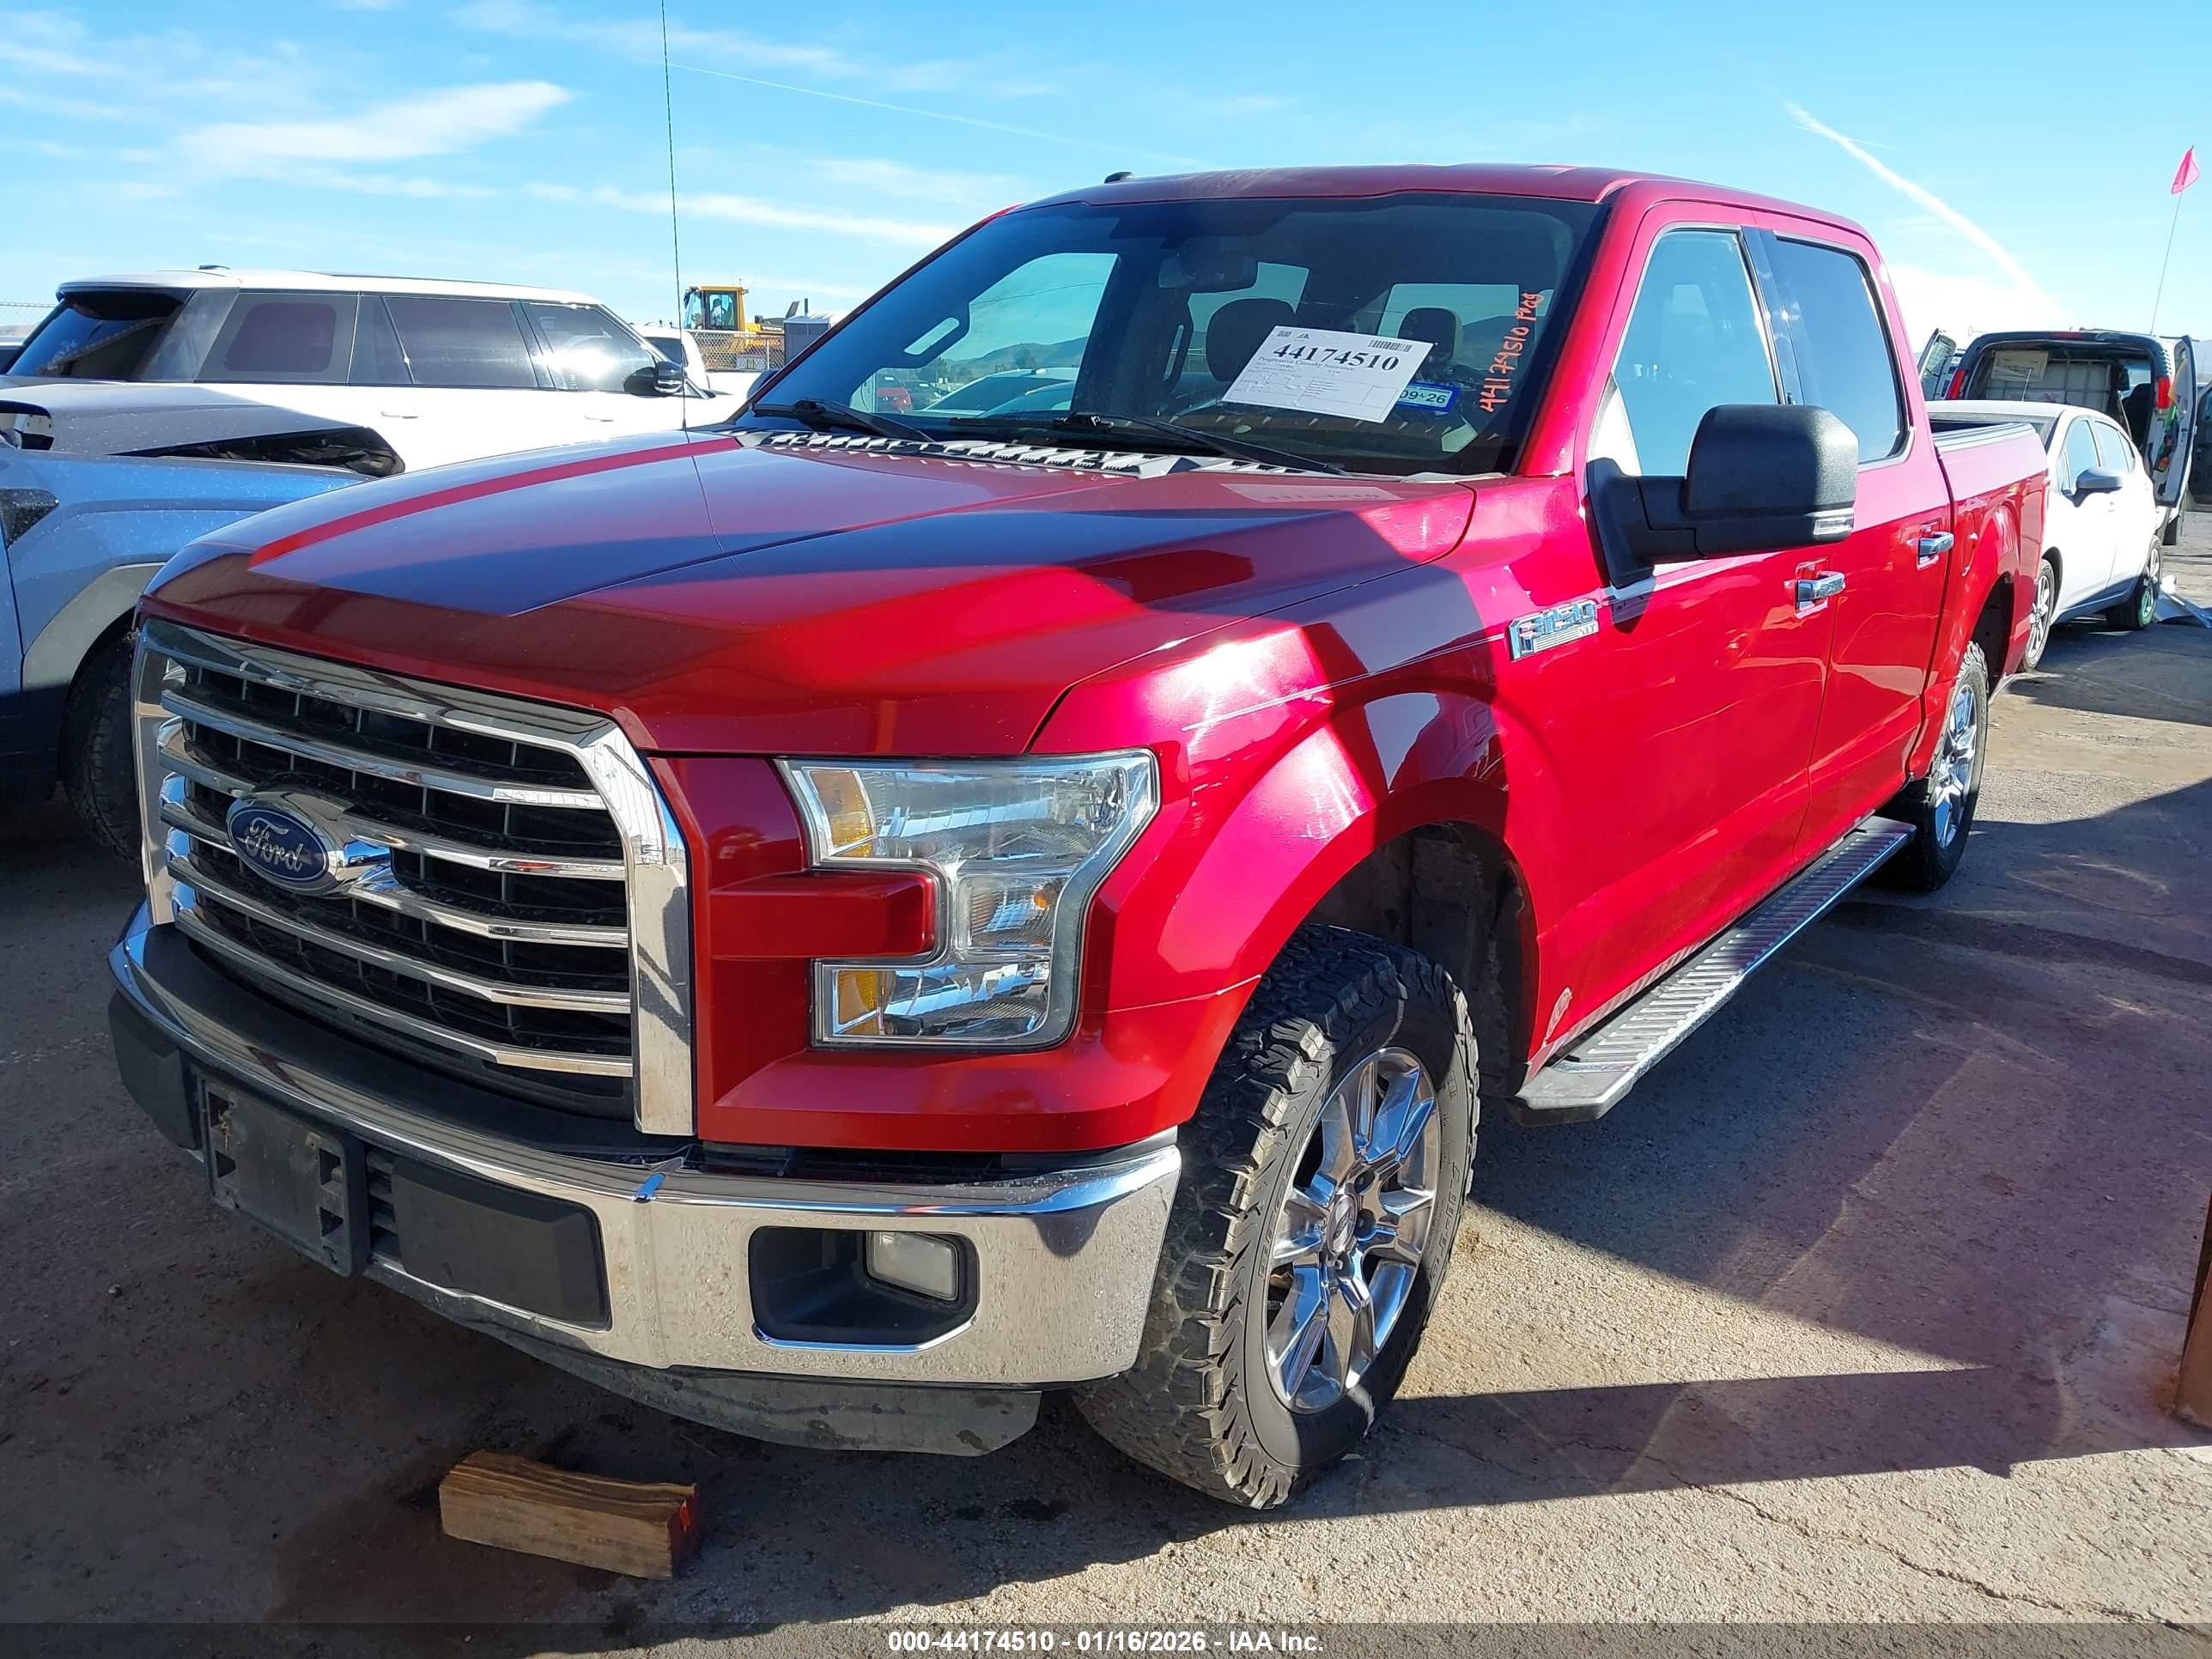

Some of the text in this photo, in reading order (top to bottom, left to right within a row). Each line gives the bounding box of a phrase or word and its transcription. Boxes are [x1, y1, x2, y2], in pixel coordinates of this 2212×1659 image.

[1258, 356, 1294, 365] Progressive
[1295, 360, 1322, 368] Casualty
[1323, 363, 1356, 372] Insurance
[1273, 343, 1400, 371] 44174510
[1478, 325, 1530, 413] 44174510
[1425, 392, 1447, 404] 26
[244, 817, 305, 872] Ford
